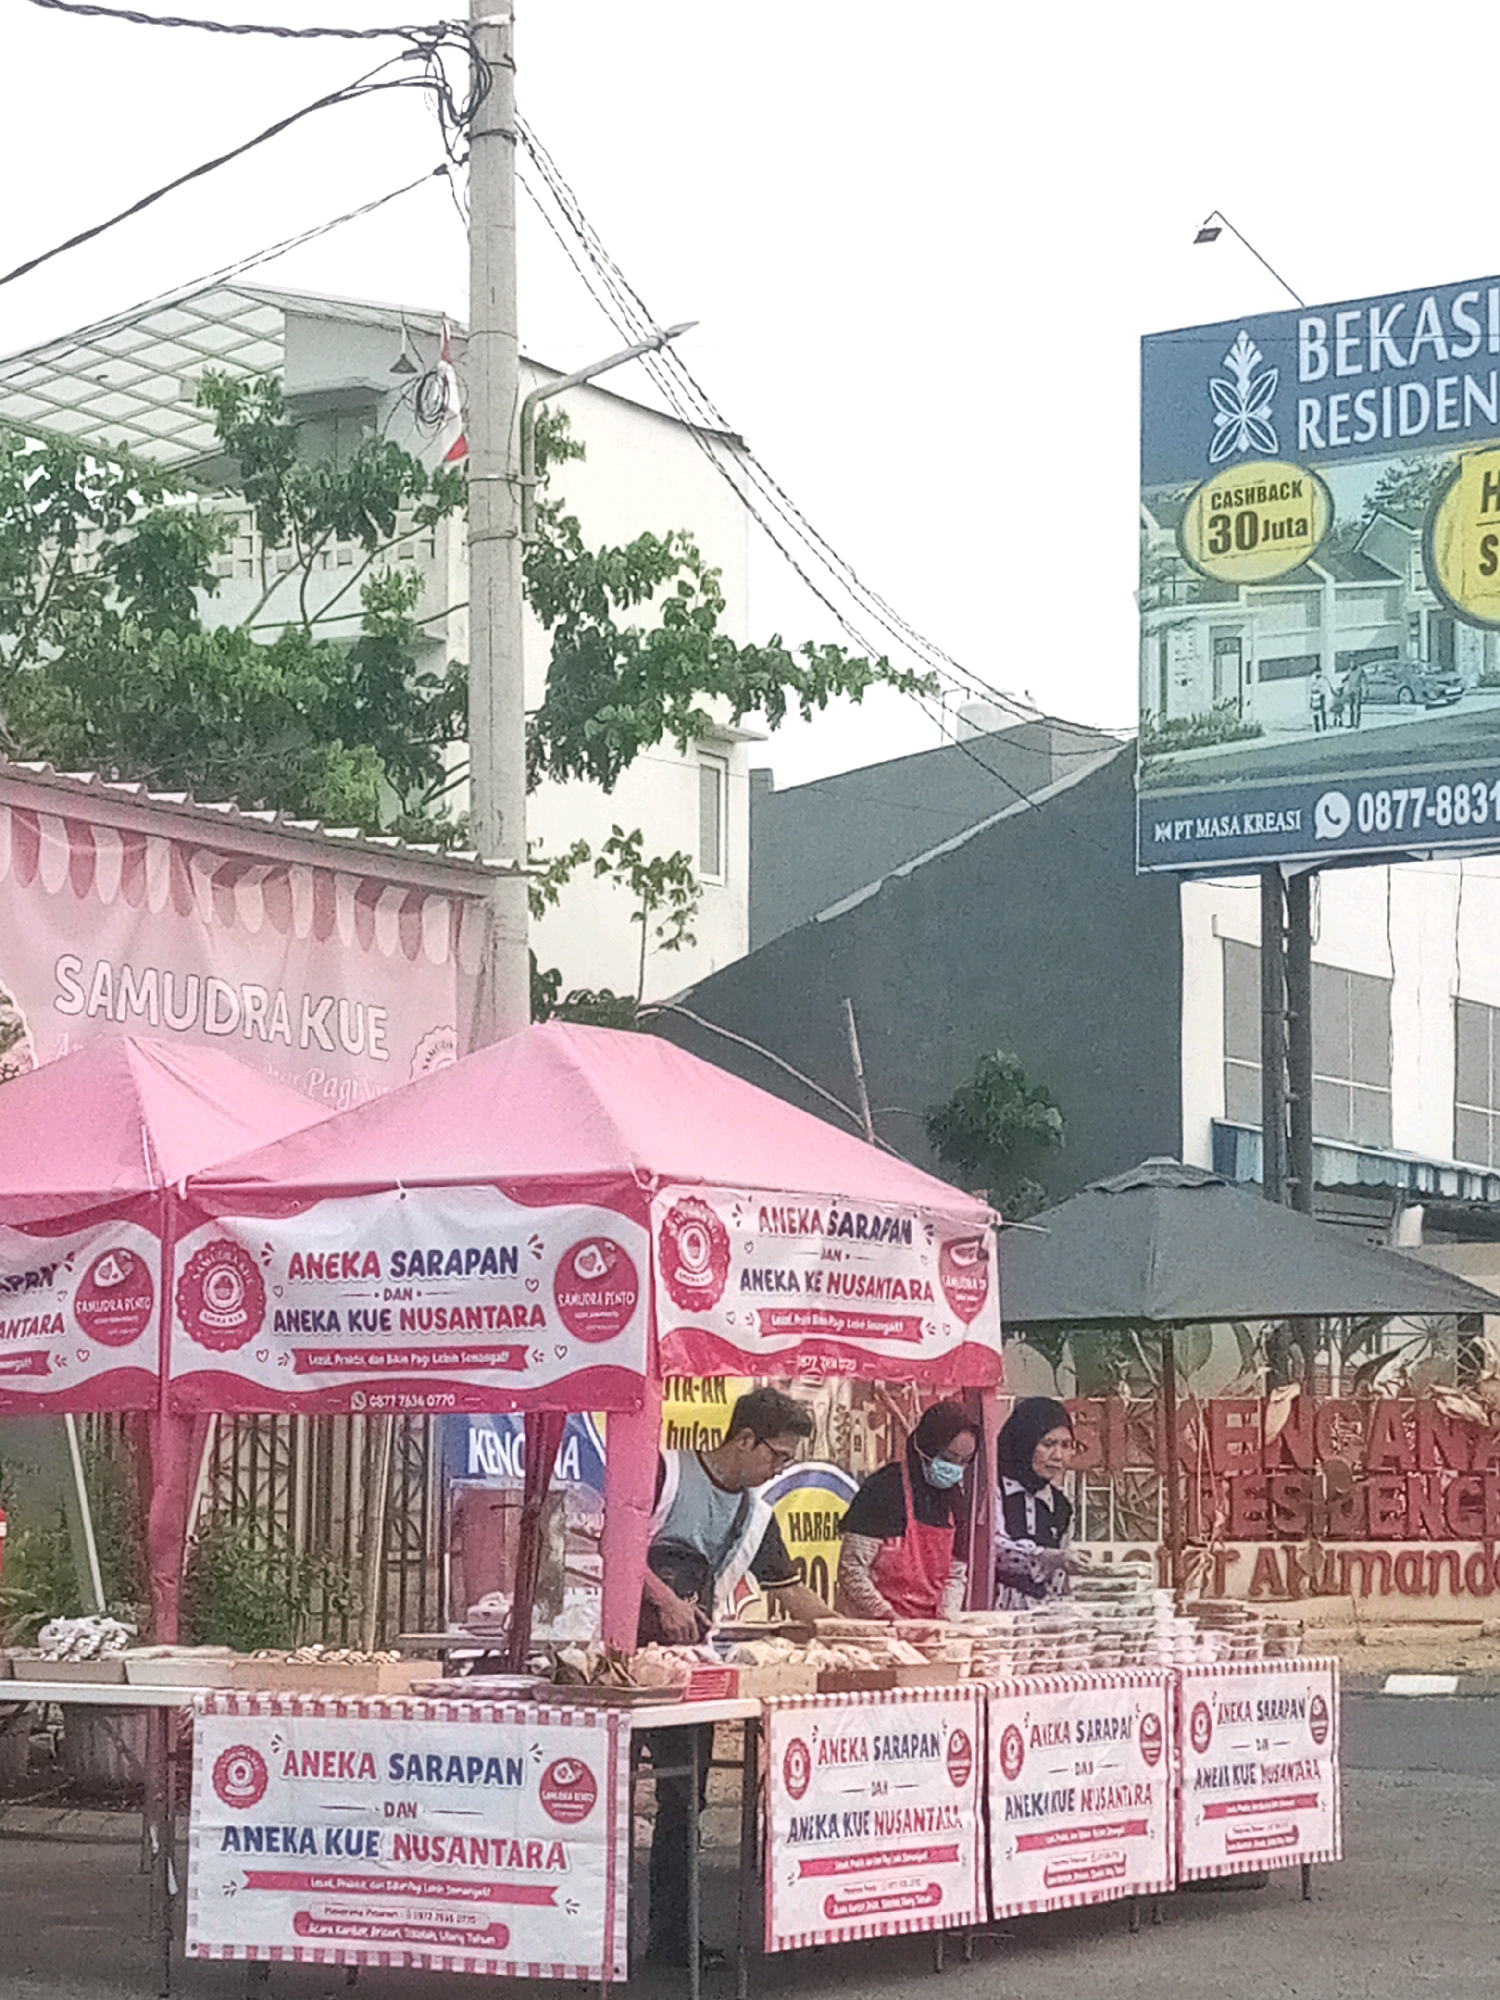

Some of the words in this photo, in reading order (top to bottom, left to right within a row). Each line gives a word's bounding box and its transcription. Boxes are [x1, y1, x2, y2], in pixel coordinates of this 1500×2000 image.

[1299, 287, 1500, 383] BEKASI
[1299, 371, 1500, 451] RESIDEN
[1210, 481, 1303, 511] CASHBACK
[1208, 511, 1259, 555] 30
[1260, 516, 1309, 543] Juta
[1174, 819, 1194, 839] PT
[1196, 813, 1241, 838] MASA
[1243, 808, 1301, 835] KREASI
[54, 954, 293, 1047] SAMUDRA
[300, 994, 391, 1062] KUE
[758, 1205, 825, 1236] ANEKA
[826, 1209, 914, 1246] SARAPAN
[287, 1251, 381, 1281] ANEKA
[389, 1245, 520, 1280] SARAPAN
[383, 1287, 414, 1302] DAN
[740, 1268, 801, 1293] ANEKA
[274, 1309, 342, 1334] ANEKA
[349, 1309, 392, 1333] KUE
[400, 1304, 547, 1331] NUSANTARA
[787, 1510, 843, 1543] HARGA
[1216, 1700, 1253, 1726] ANEKA
[1256, 1697, 1306, 1722] SARAPAN
[818, 1736, 870, 1766] ANEKA
[873, 1733, 941, 1762] SARAPAN
[282, 1748, 378, 1780] ANEKA
[387, 1752, 525, 1787] SARAPAN
[1232, 1762, 1257, 1786] KUE
[384, 1801, 418, 1820] DAN
[786, 1813, 841, 1844] ANEKA
[842, 1810, 871, 1838] KUE
[874, 1804, 963, 1837] NUSANTARA
[220, 1824, 318, 1857] ANEKA
[325, 1827, 381, 1859] KUE
[392, 1832, 568, 1871] NUSANTARA
